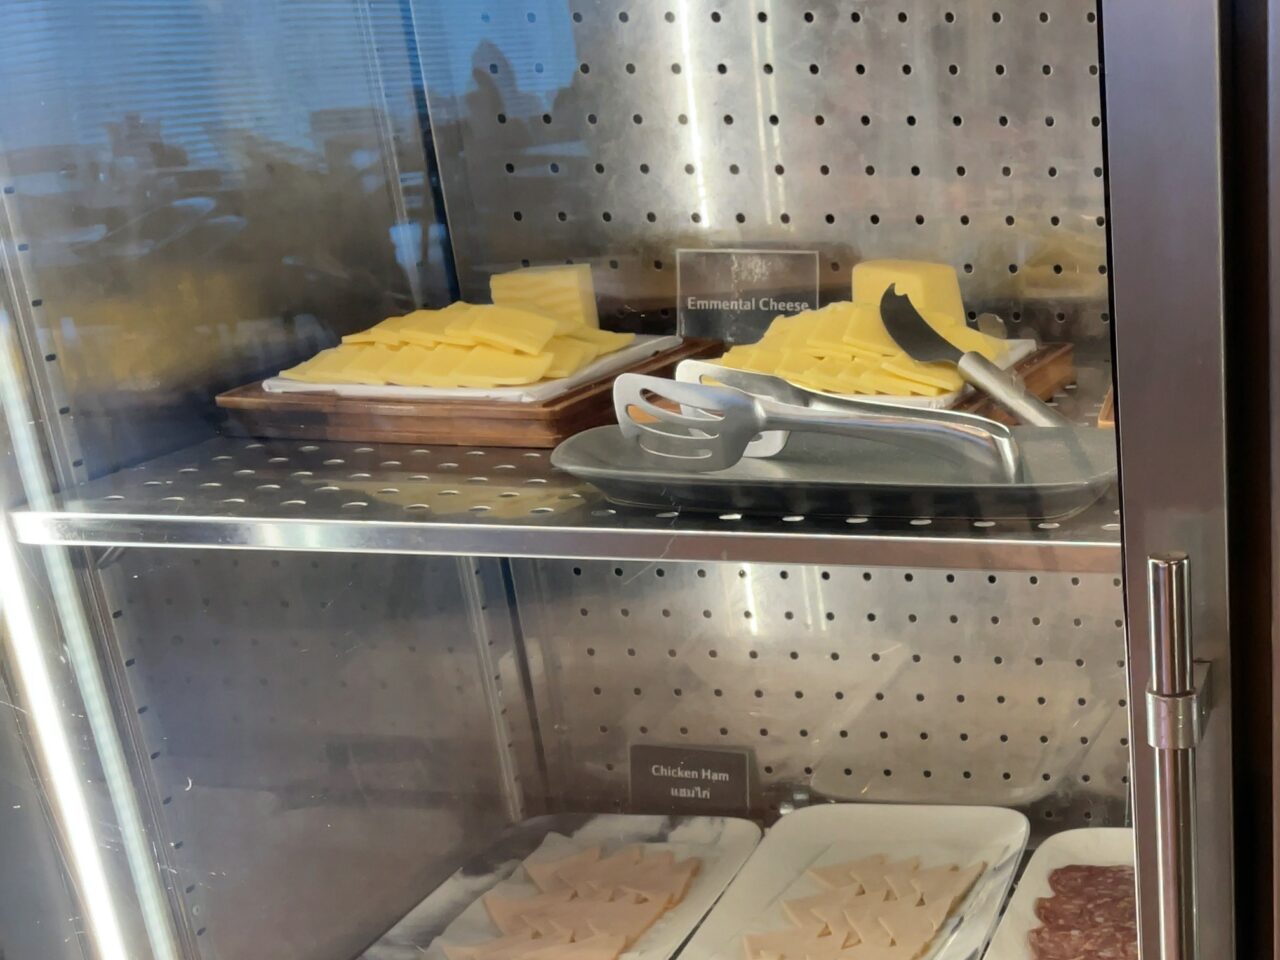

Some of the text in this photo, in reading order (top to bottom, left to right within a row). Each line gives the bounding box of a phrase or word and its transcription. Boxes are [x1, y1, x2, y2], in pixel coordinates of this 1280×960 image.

[687, 296, 810, 312] Emmental Cheese
[651, 764, 730, 782] Chicken Ham
